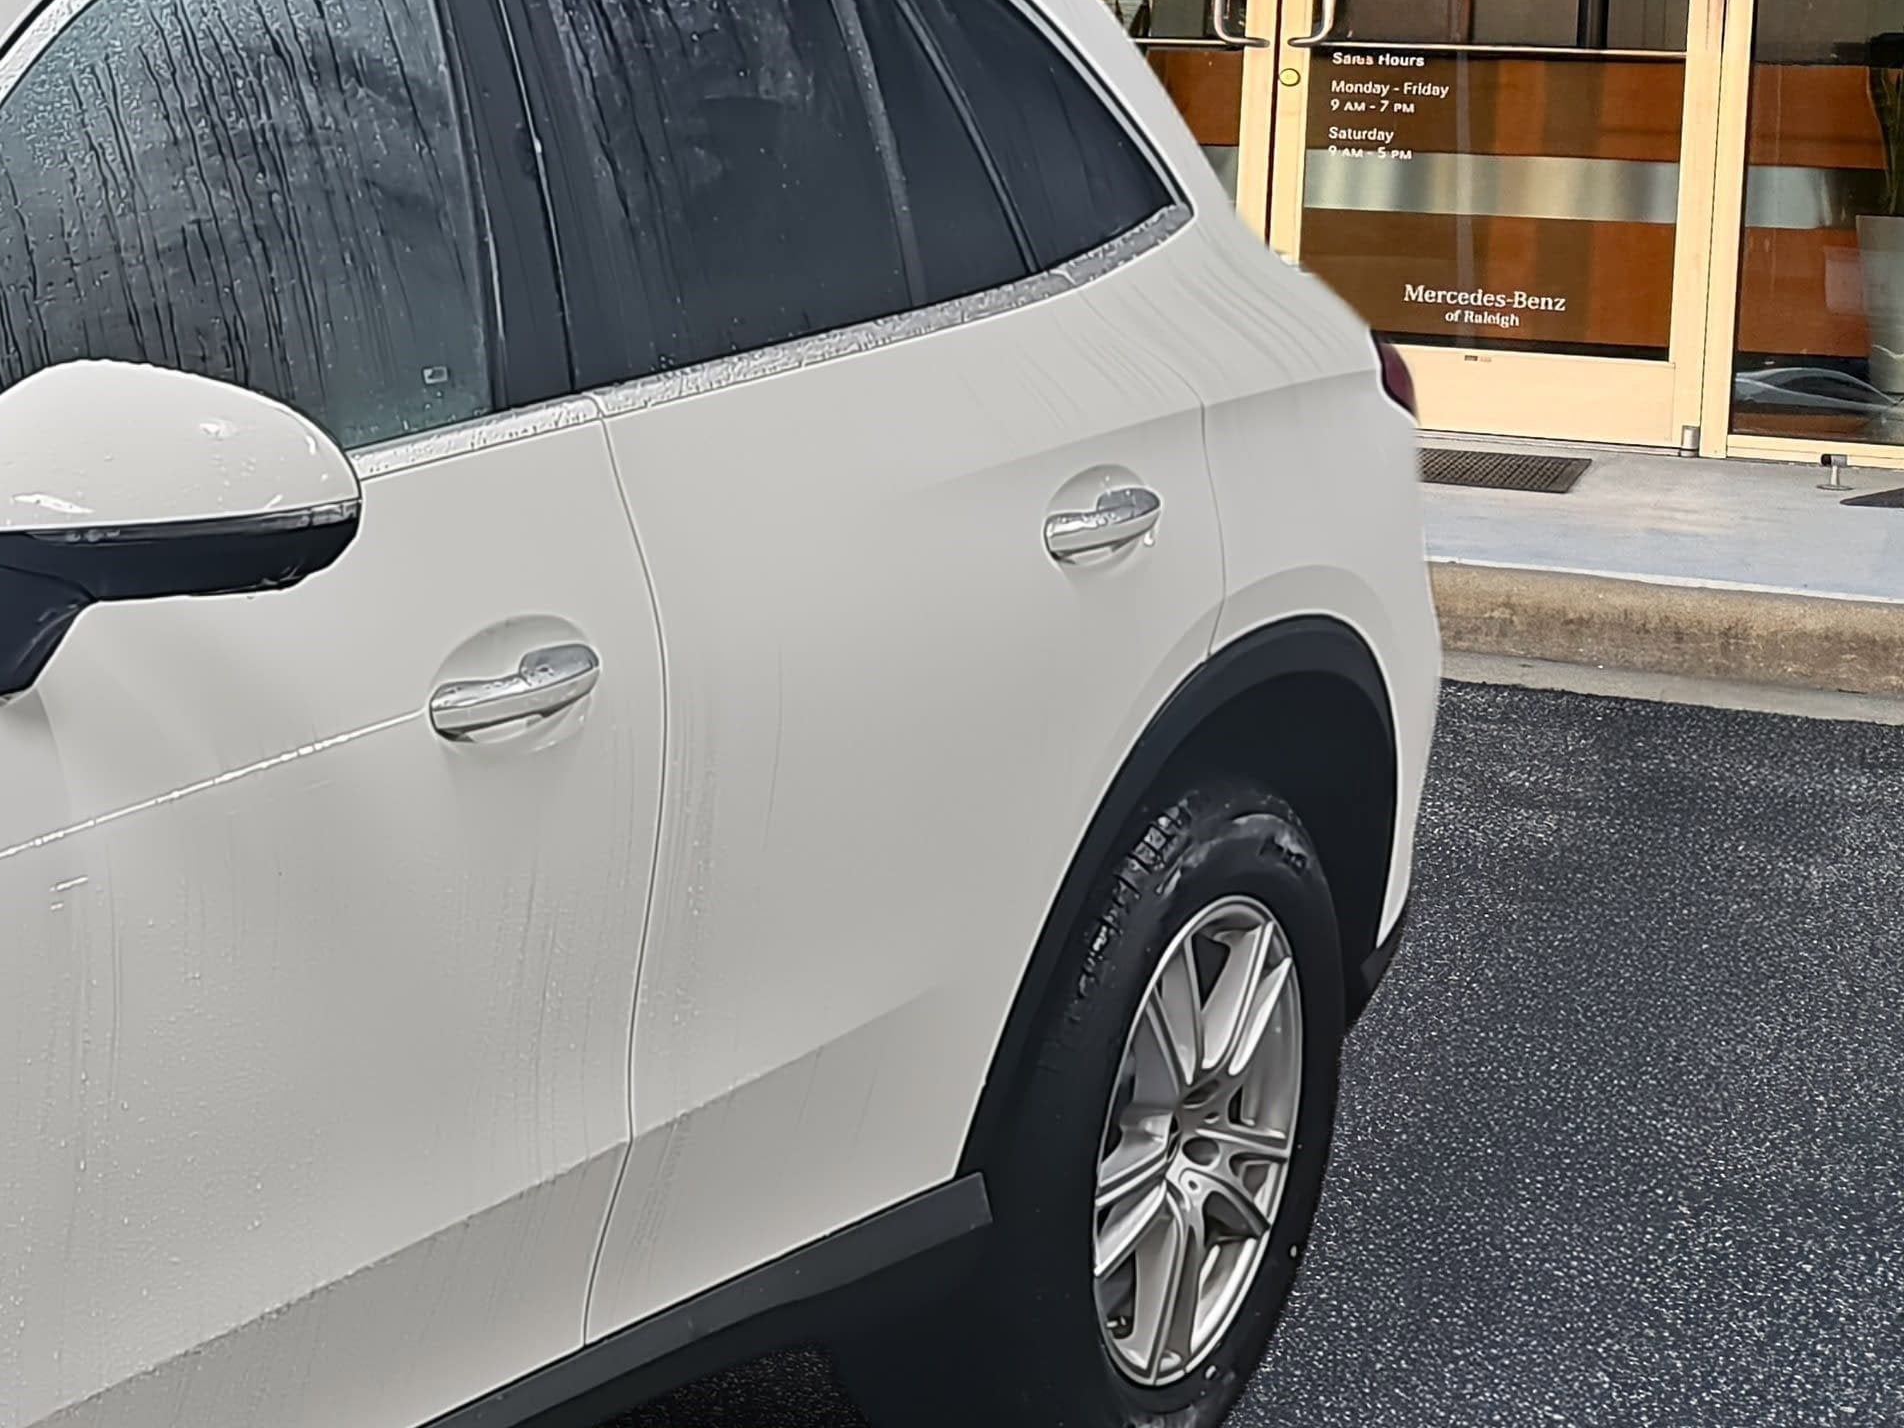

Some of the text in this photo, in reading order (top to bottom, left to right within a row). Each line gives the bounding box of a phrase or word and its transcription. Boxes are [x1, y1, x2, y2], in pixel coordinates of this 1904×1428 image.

[1378, 53, 1425, 67] Hours
[1331, 80, 1390, 97] Monday
[1403, 82, 1449, 99] Friday
[1330, 99, 1340, 111] 9
[1343, 101, 1366, 112] AM
[1380, 100, 1389, 112] 7
[1393, 103, 1415, 114] PM
[1328, 127, 1394, 144] Saturday
[1342, 147, 1364, 158] AM
[1377, 147, 1387, 158] 5
[1391, 150, 1413, 160] PM
[1403, 284, 1566, 311] Mercedes-Benz
[1445, 309, 1462, 322] of
